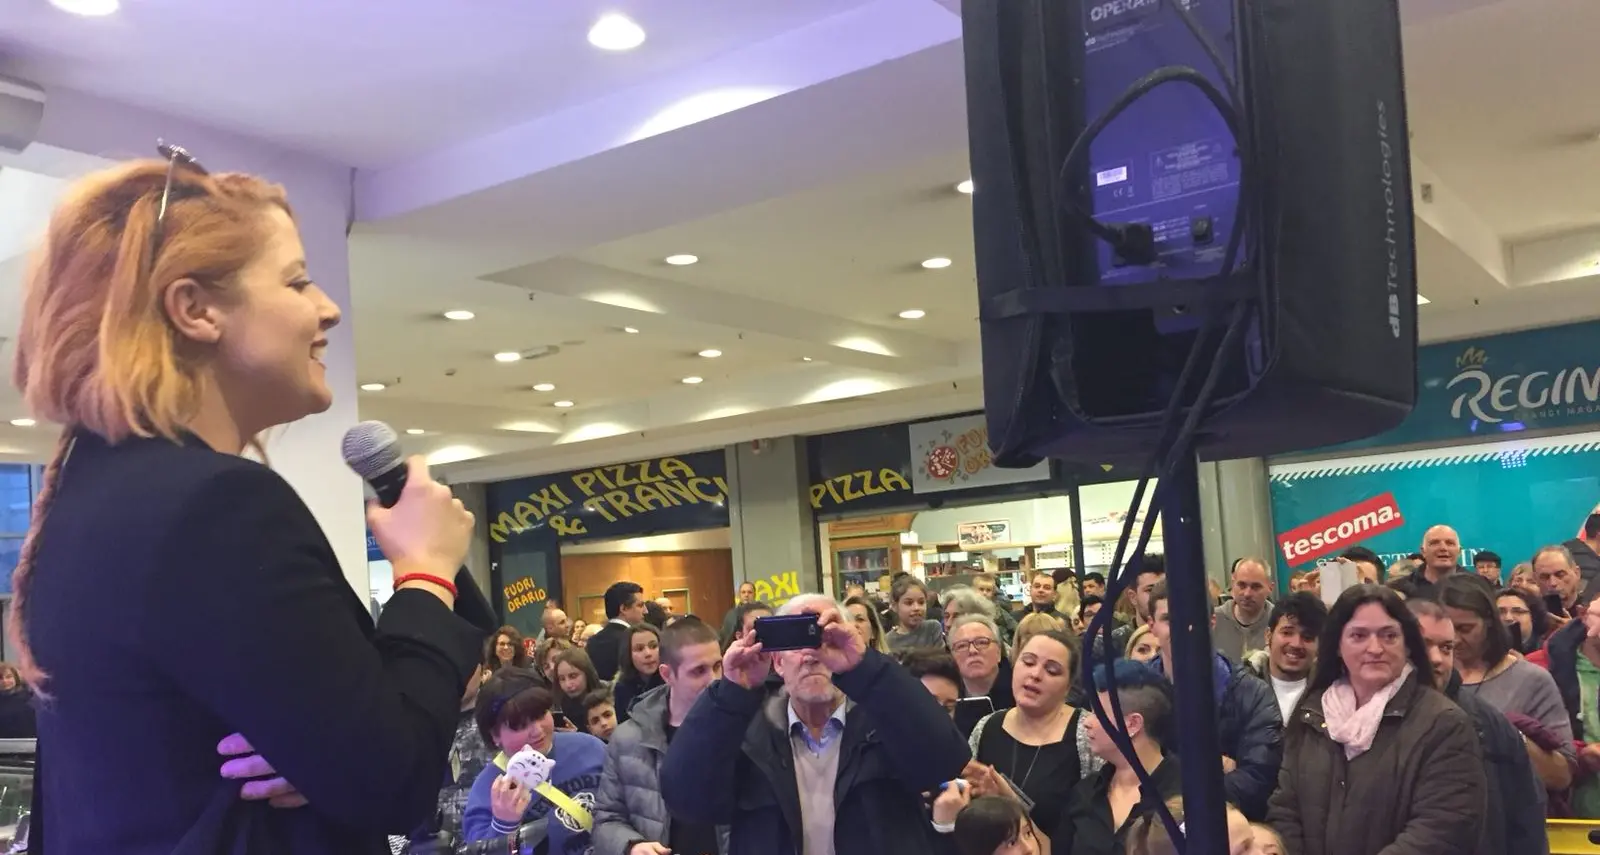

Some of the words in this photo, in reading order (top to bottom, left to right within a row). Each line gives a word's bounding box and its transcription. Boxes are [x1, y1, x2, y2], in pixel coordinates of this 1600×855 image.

[1446, 366, 1600, 423] REGIN
[956, 428, 987, 455] FU
[490, 483, 573, 543] MAXI
[571, 457, 696, 497] PIZZA
[809, 468, 911, 509] PIZZA
[549, 514, 588, 536] &
[504, 577, 535, 600] FUORI
[508, 588, 546, 613] ORARIO
[753, 571, 800, 602] AXI
